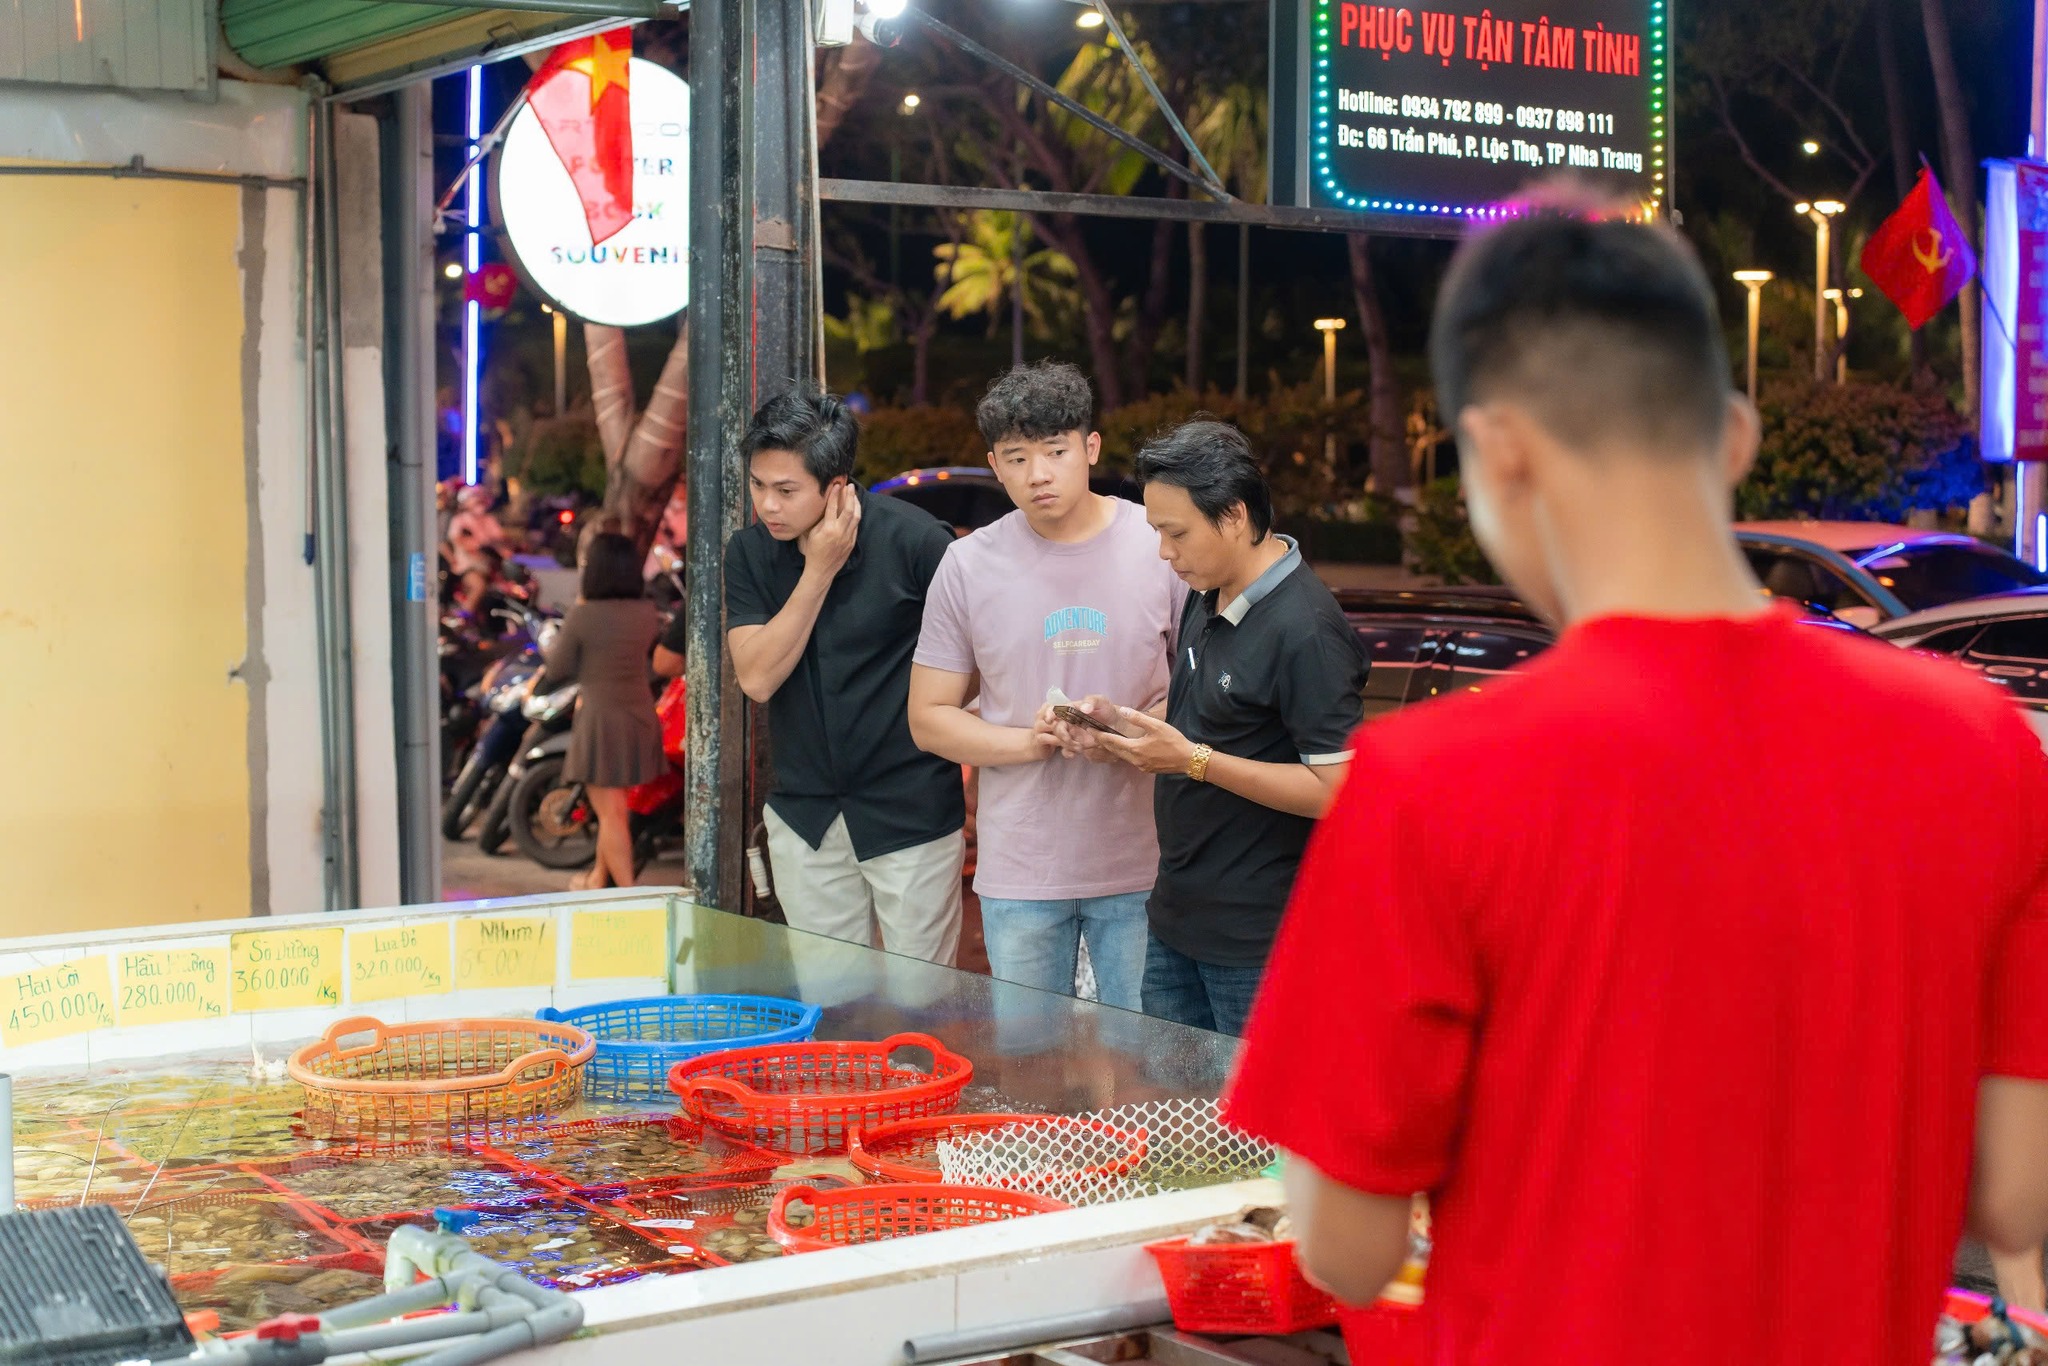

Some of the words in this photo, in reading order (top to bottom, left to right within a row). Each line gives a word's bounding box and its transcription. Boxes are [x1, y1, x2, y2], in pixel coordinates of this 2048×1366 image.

[1340, 2, 1413, 61] PHỤC
[1421, 11, 1456, 67] VỤ
[1463, 8, 1514, 71] TẬN
[1521, 15, 1575, 70] TÂM
[1582, 21, 1640, 77] TÌNH
[1338, 88, 1399, 116] Hotline:
[1401, 94, 1440, 120] 0934
[1442, 98, 1472, 122] 792
[1474, 101, 1504, 126] 899
[1516, 105, 1554, 130] 0937
[1556, 109, 1585, 133] 898
[1587, 112, 1614, 135] 111
[1338, 124, 1364, 148] Đc:
[1367, 126, 1388, 150] 66
[1390, 126, 1425, 153] Trần
[1427, 131, 1462, 159] Phú,
[1465, 135, 1479, 158] P.
[1481, 136, 1509, 164] Lộc
[1511, 139, 1544, 167] Thọ,
[1546, 142, 1565, 165] TP
[1568, 144, 1599, 168] Nha
[1601, 146, 1643, 173] Trang
[550, 246, 688, 265] SOUVENI
[1044, 606, 1107, 641] ADVENTURE
[16, 975, 51, 1000] Hai
